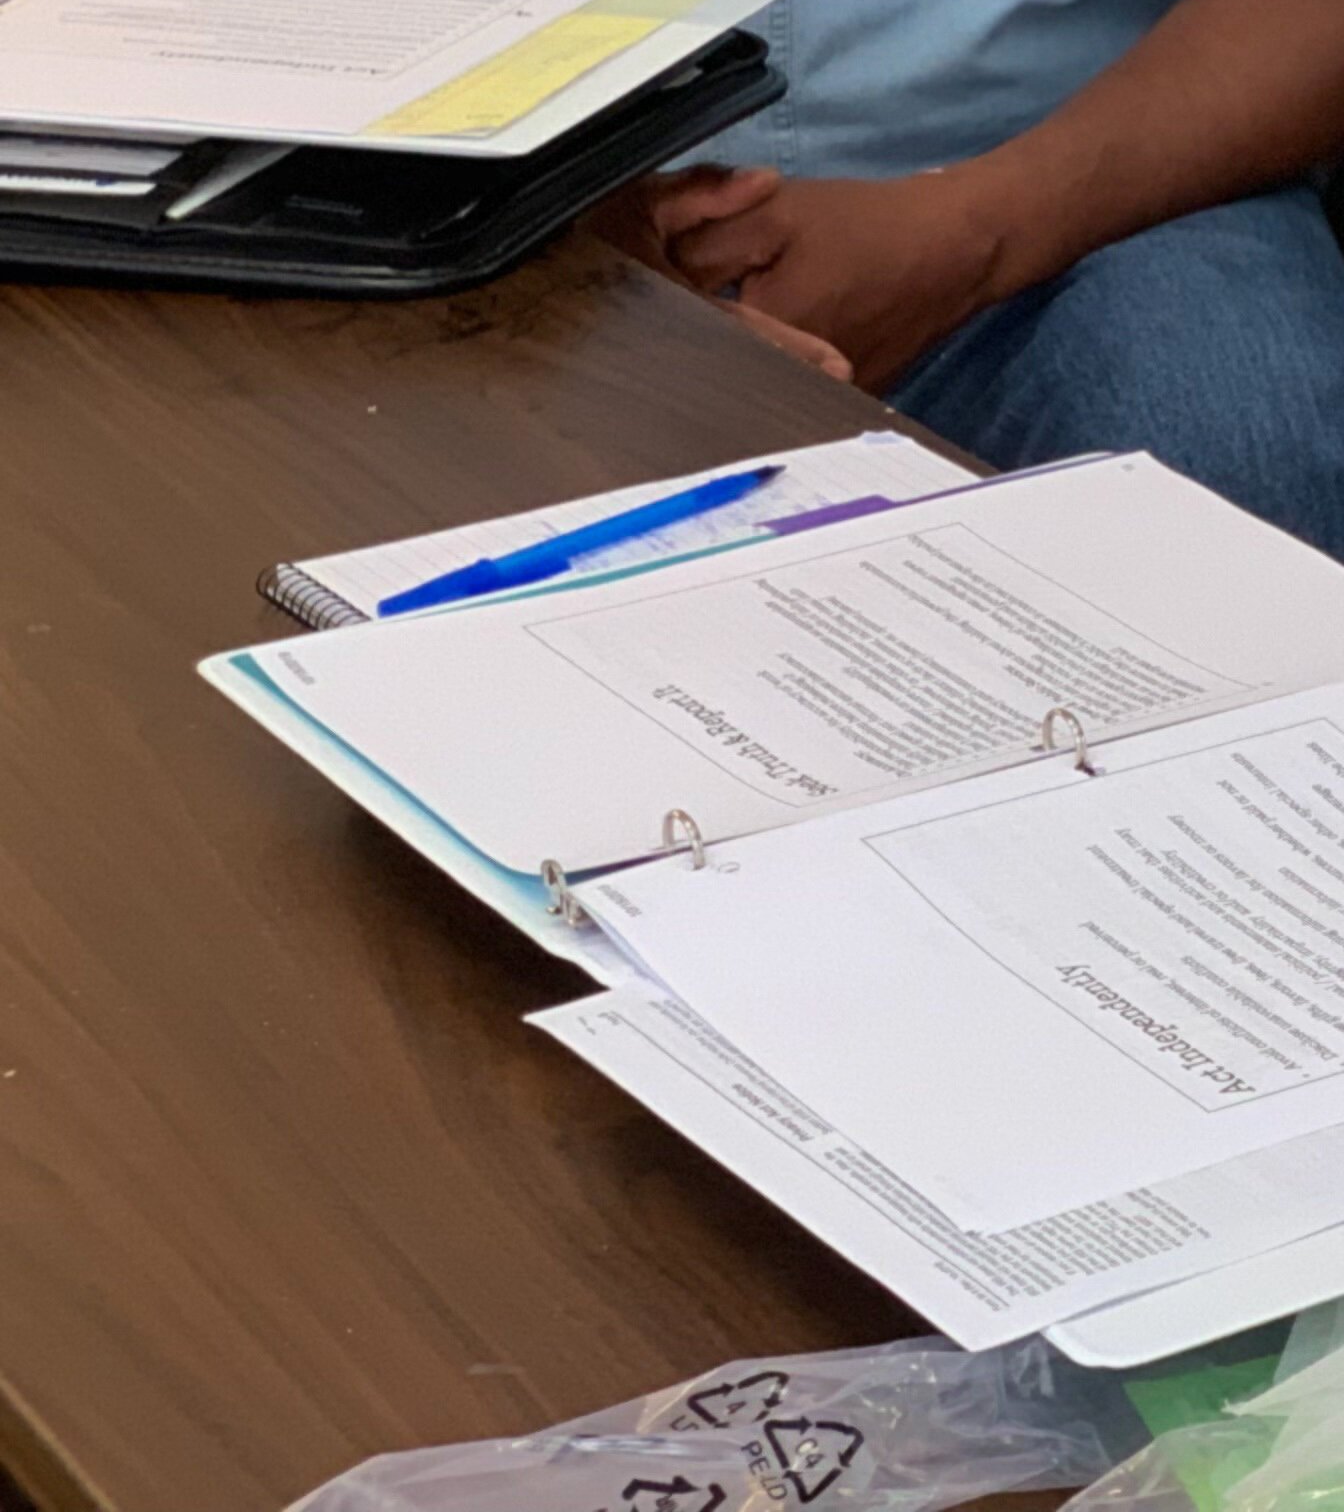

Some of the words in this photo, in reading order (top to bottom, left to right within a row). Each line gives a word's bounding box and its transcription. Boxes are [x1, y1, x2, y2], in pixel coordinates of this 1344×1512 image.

[653, 684, 682, 698] It
[659, 694, 736, 736] Report
[722, 732, 749, 745] &
[738, 742, 796, 778] Truth
[786, 774, 837, 796] Seek
[1057, 965, 1212, 1069] Independently
[1200, 1065, 1255, 1093] Act
